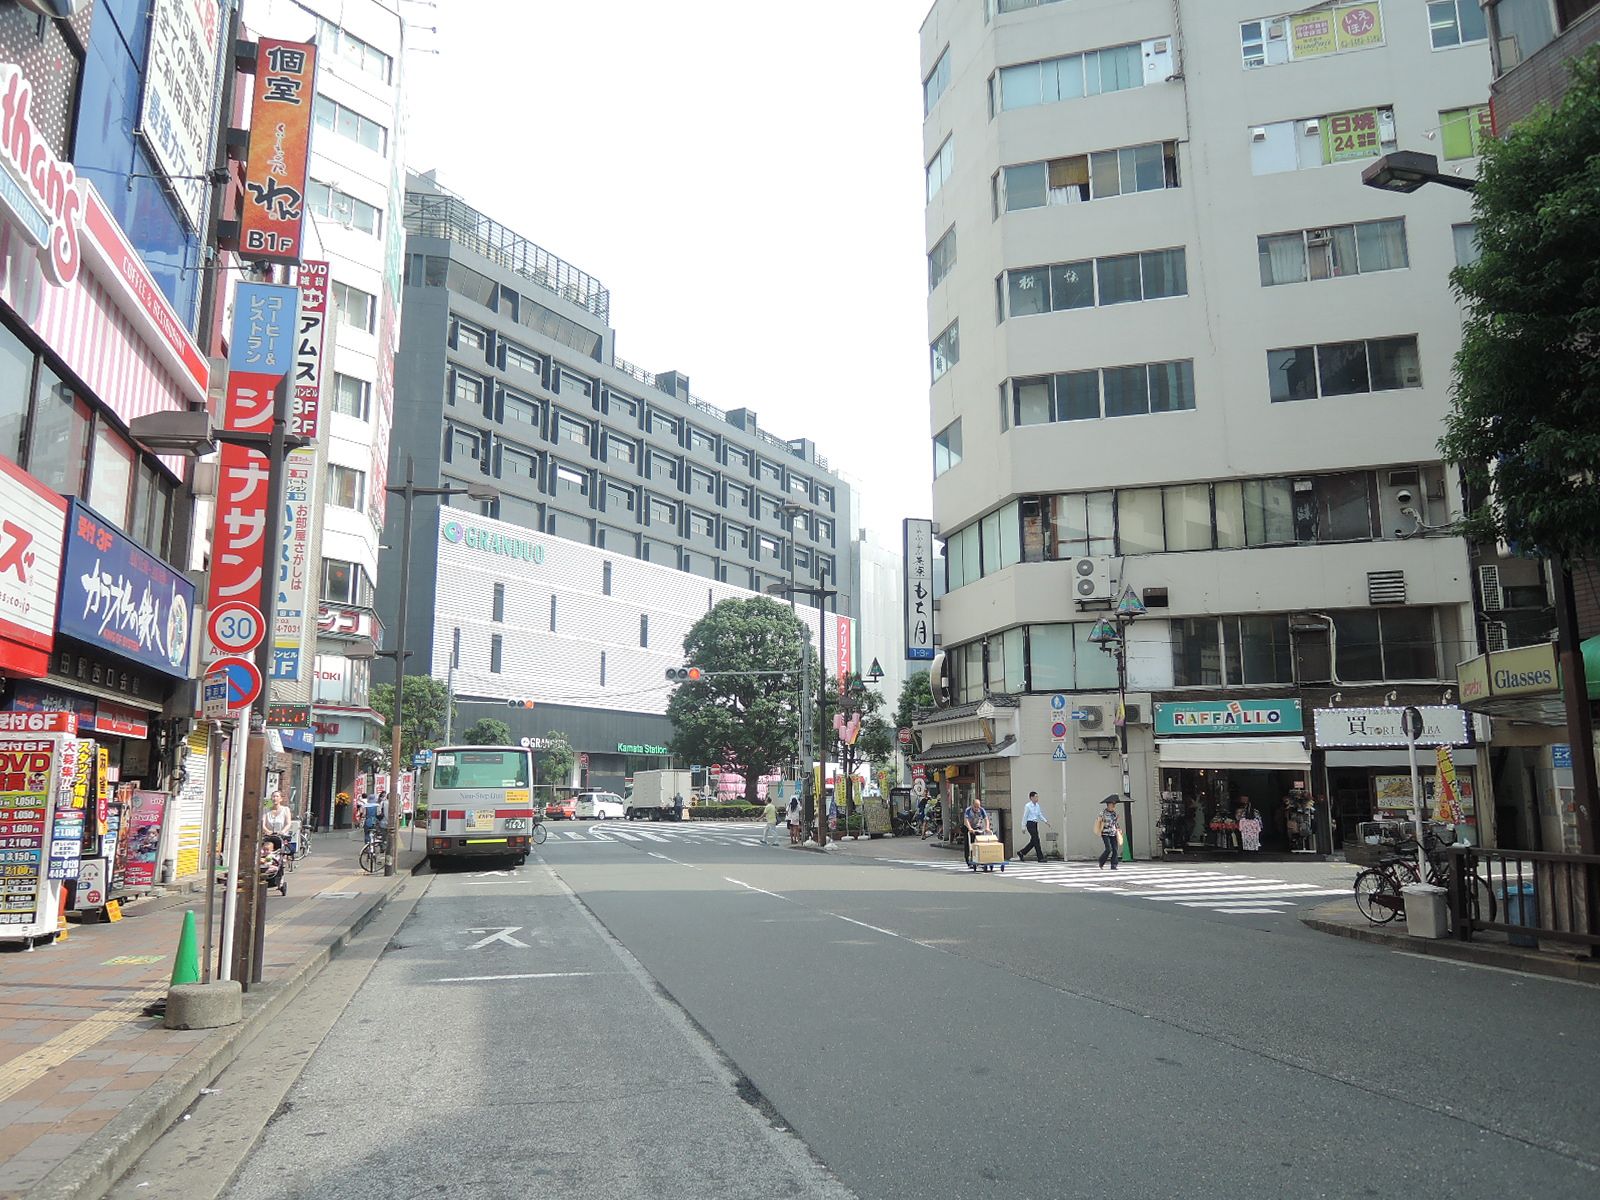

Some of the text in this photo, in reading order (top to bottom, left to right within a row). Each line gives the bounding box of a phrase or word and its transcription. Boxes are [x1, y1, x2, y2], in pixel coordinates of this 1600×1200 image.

[264, 46, 306, 105] 個室
[1333, 134, 1355, 152] 24
[248, 230, 294, 252] B1F
[245, 294, 266, 364] レストラン
[296, 315, 321, 382] アムス
[291, 419, 316, 434] 2F
[290, 503, 308, 591] お部屋さがしは
[465, 526, 545, 565] GRANDUO
[913, 580, 928, 645] もち月
[221, 616, 252, 639] 30
[1494, 668, 1552, 689] Glasses
[1174, 702, 1280, 725] RAFFAELLO
[617, 742, 668, 754] Kamata Station
